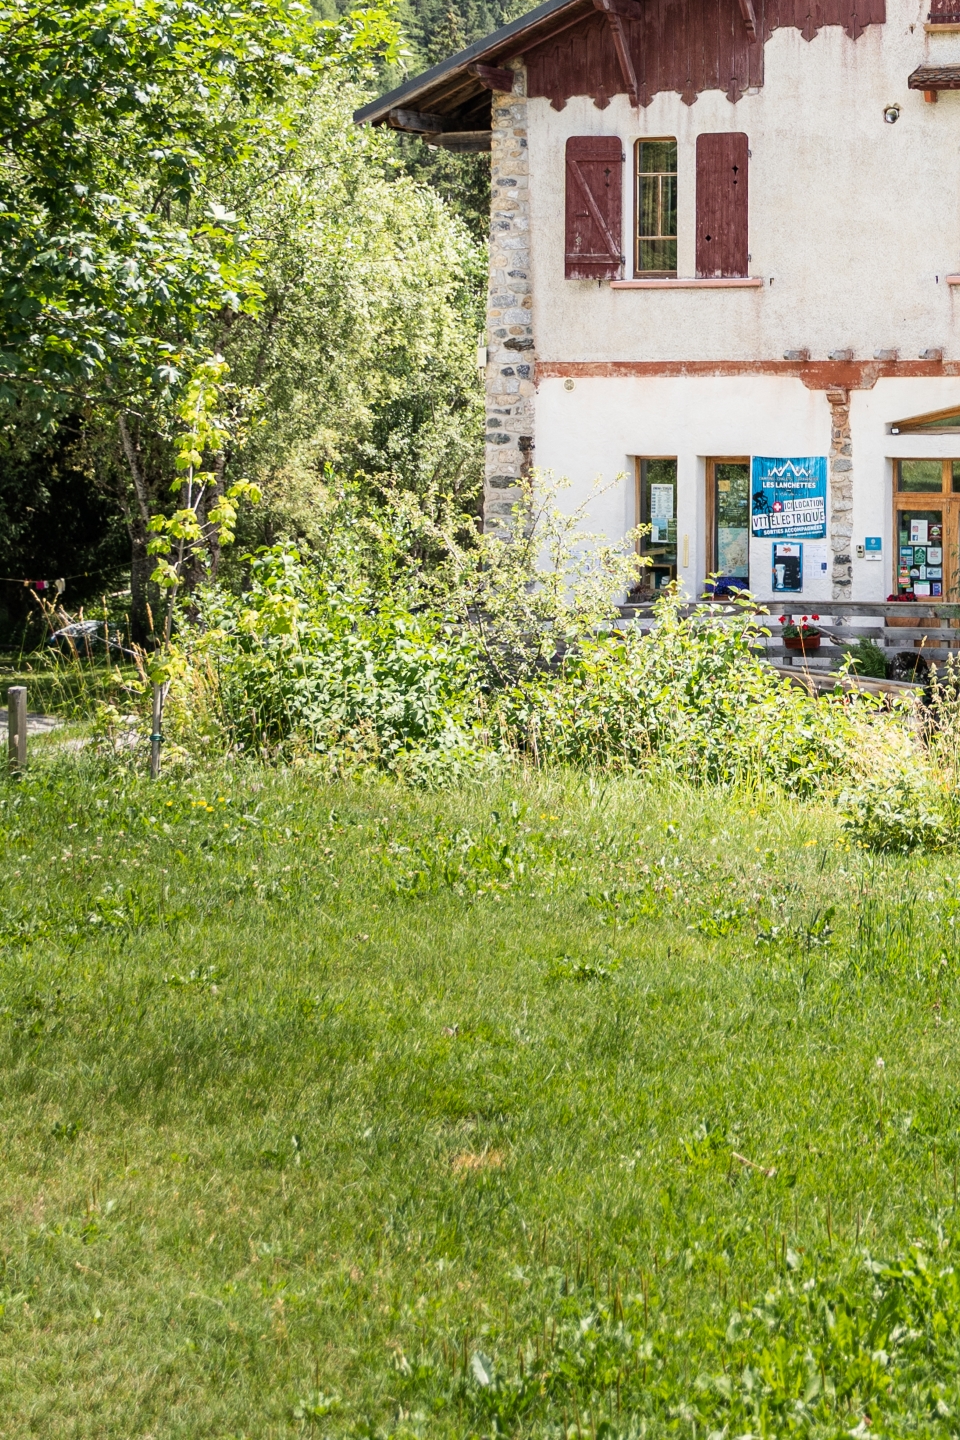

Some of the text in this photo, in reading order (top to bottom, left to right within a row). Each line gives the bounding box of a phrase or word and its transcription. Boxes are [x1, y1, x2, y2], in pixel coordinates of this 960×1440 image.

[784, 499, 824, 509] ICI LOCATION
[753, 516, 768, 528] VTT
